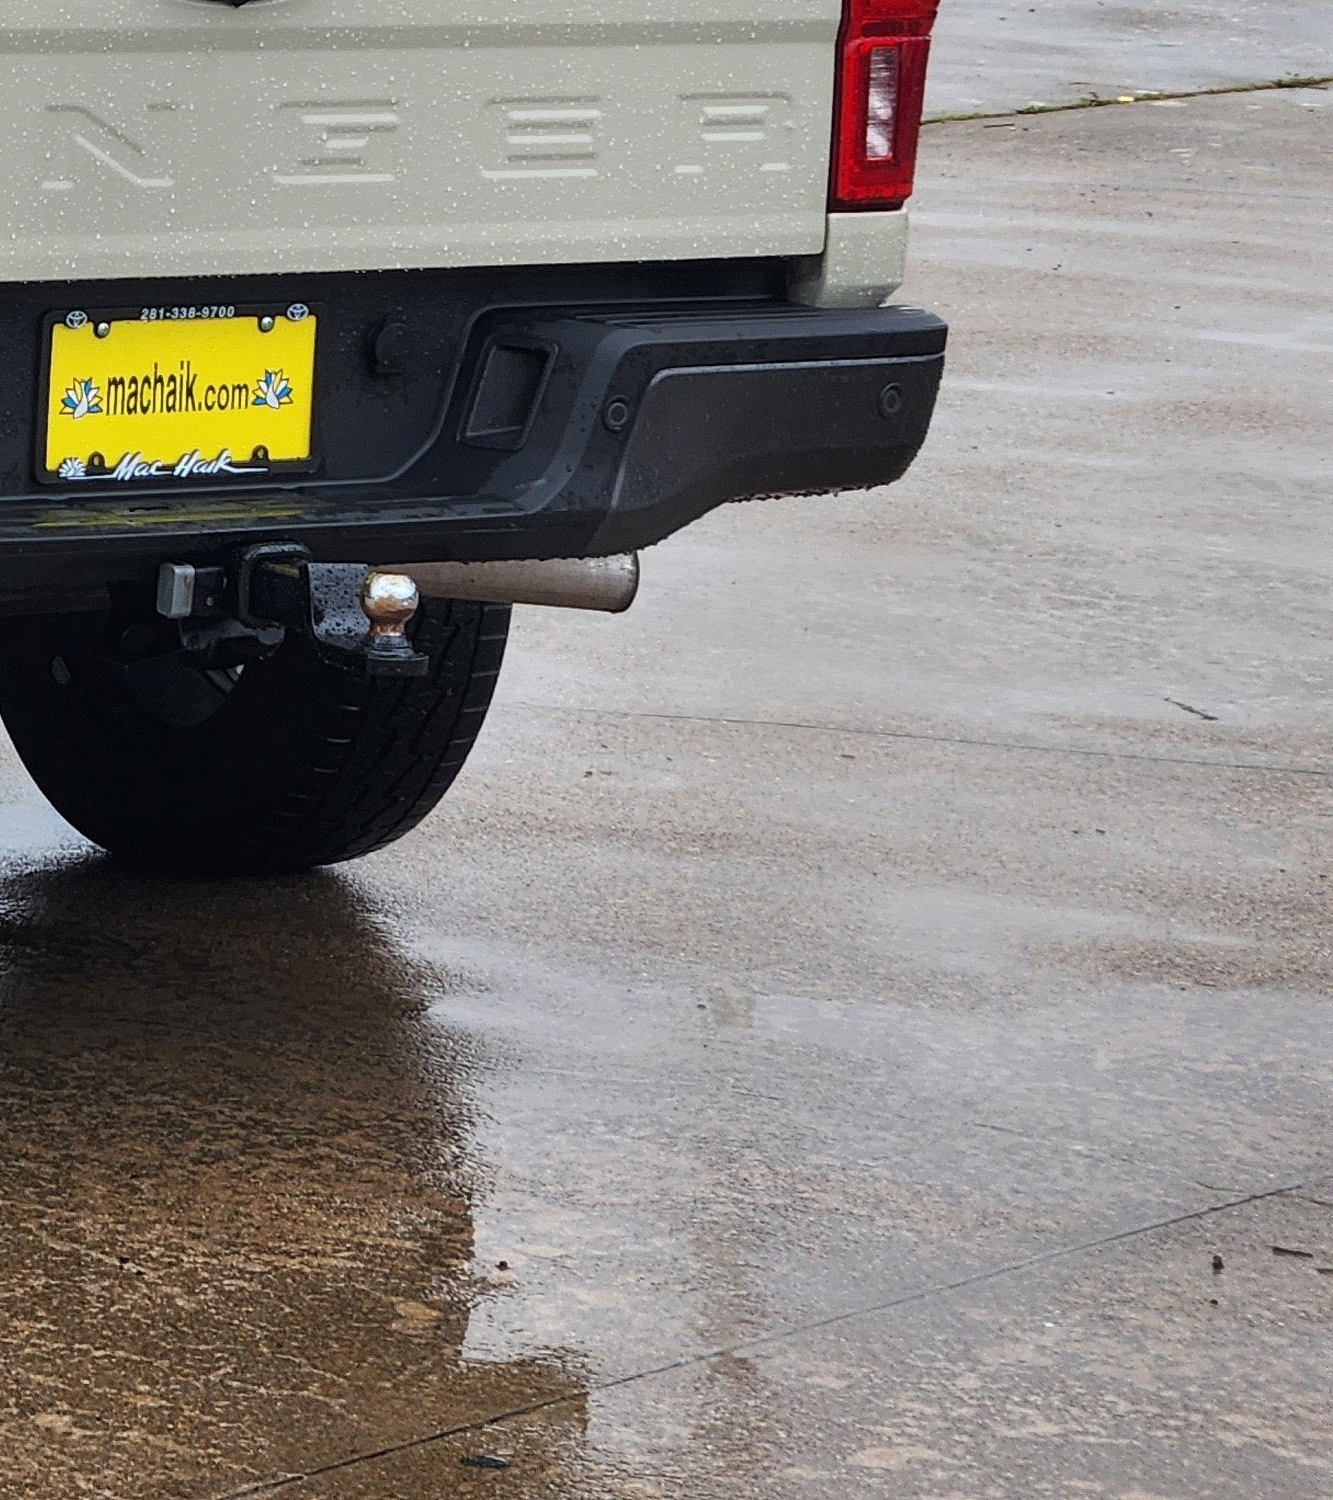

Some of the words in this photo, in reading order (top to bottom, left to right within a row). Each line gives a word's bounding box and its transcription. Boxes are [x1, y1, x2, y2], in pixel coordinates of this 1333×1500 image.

[139, 305, 235, 321] 281-338-9700
[105, 360, 250, 416] machaik.com
[103, 450, 171, 481] Mac
[171, 448, 247, 477] Haik
